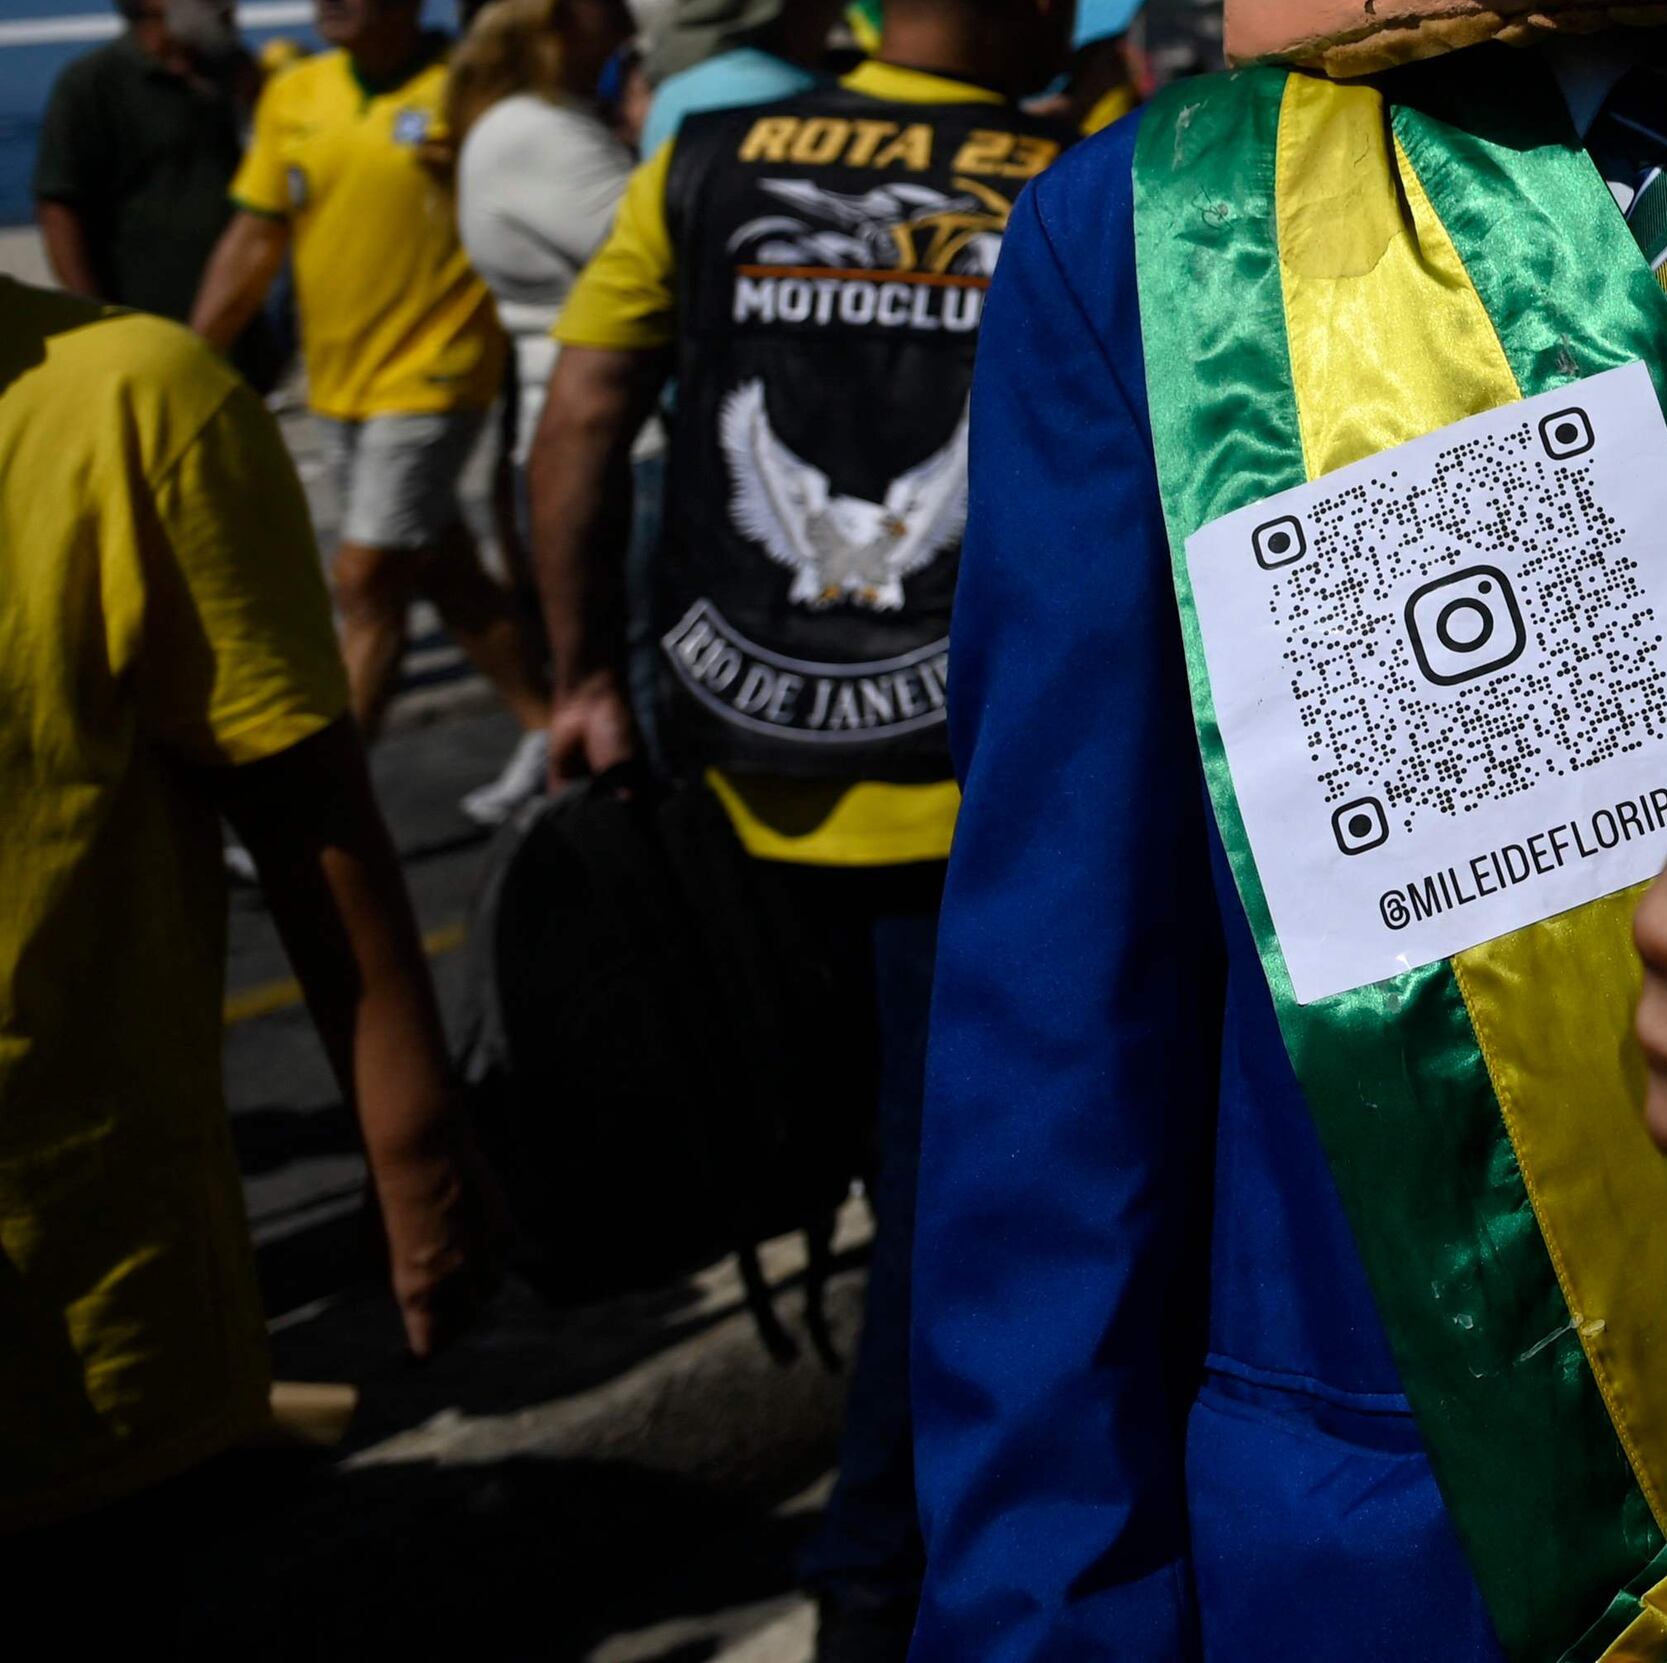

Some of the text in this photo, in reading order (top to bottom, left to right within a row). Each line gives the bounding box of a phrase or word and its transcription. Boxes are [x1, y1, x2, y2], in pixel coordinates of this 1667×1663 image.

[738, 116, 1060, 178] ROTA 23
[733, 276, 984, 332] MOTOCLU
[678, 620, 948, 729] RIO DE JANEI
